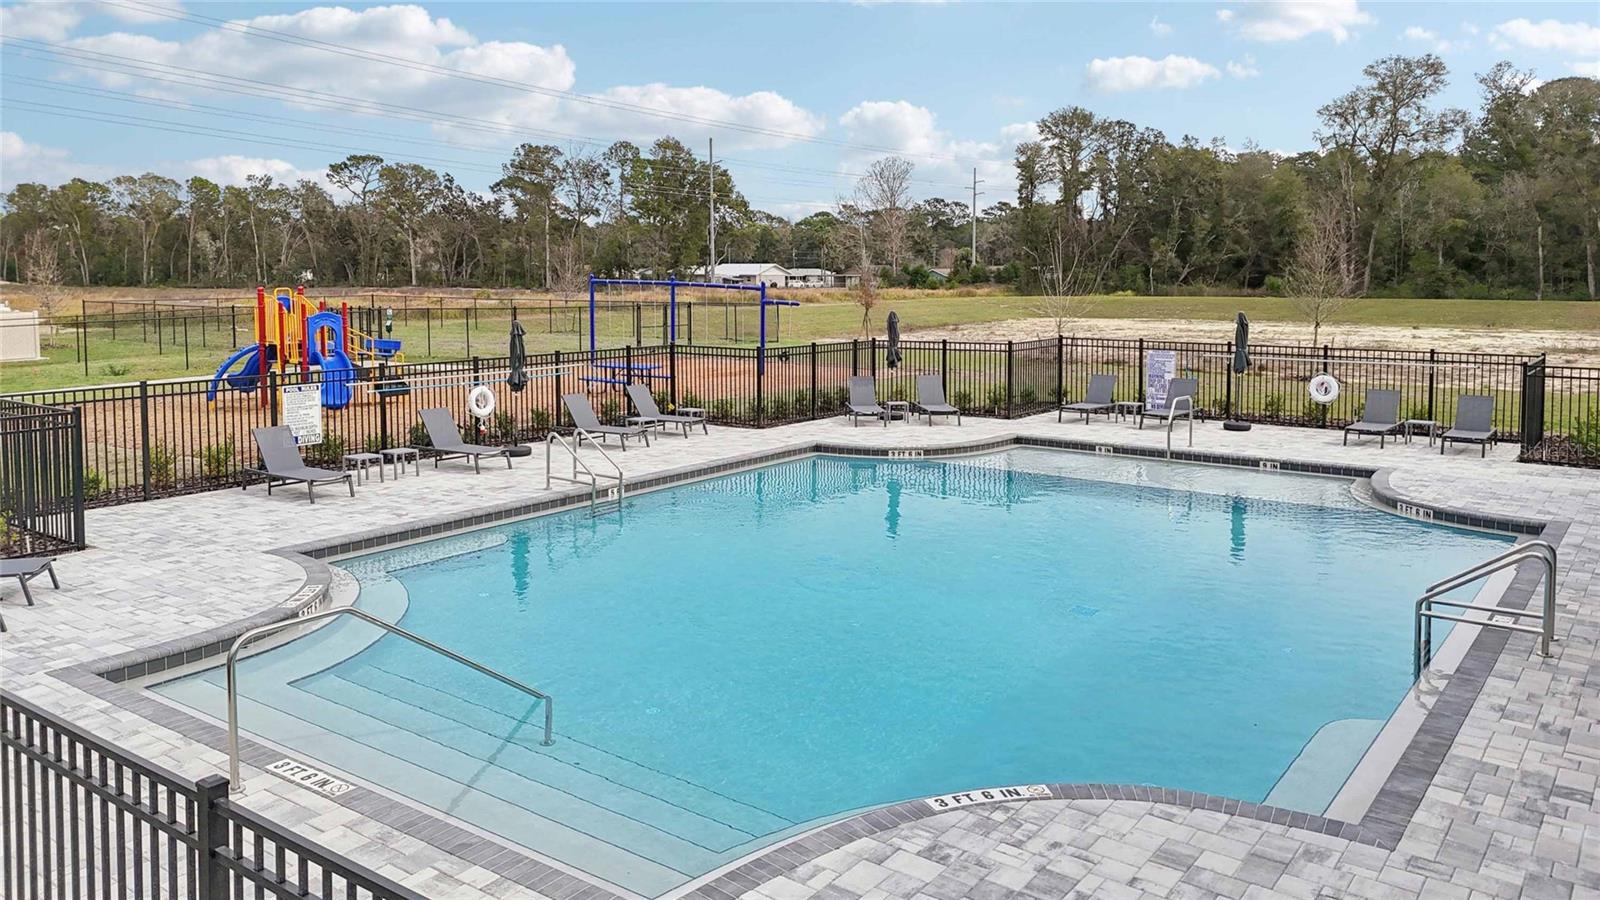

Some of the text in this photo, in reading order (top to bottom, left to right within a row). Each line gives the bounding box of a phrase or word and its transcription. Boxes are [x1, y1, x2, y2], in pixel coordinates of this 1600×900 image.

[298, 434, 320, 444] DIVING
[1399, 503, 1431, 519] 3 FT 6 IN
[274, 761, 291, 769] 3
[301, 773, 318, 781] 6
[934, 797, 949, 808] 3
[981, 790, 994, 800] 6
[999, 787, 1025, 798] IN.
